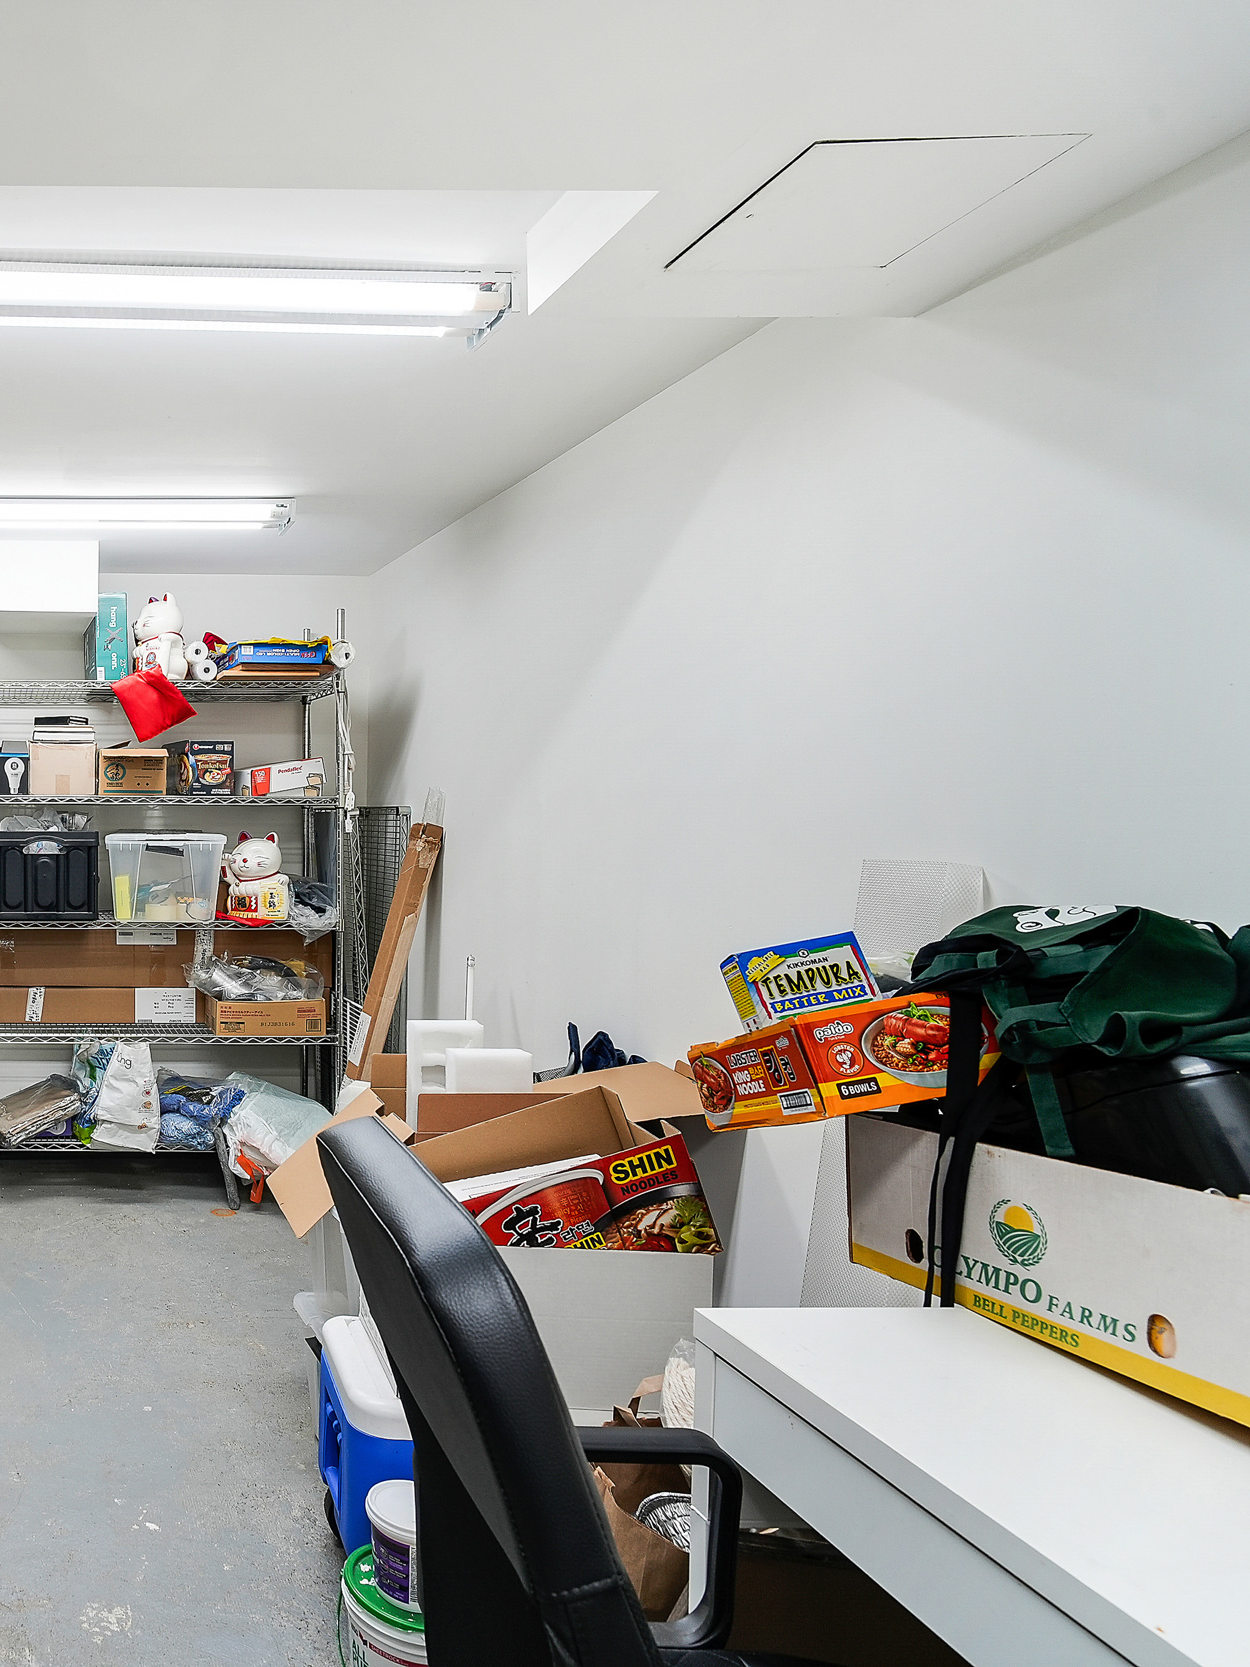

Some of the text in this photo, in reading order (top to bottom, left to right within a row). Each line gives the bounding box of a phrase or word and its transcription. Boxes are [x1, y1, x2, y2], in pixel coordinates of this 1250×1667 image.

[197, 761, 227, 769] Tonkotsu
[277, 765, 303, 774] Pendaflex
[787, 957, 829, 970] KIKKOMAN
[761, 961, 861, 998] TEMPURA
[774, 987, 865, 1011] BATTER MIX
[814, 1020, 854, 1043] paldo
[726, 1049, 760, 1069] LOBSTER
[831, 1044, 855, 1054] LOBSTER
[733, 1071, 750, 1083] KING
[840, 1064, 860, 1074] FLAVOR
[737, 1080, 766, 1095] NOODLE
[841, 1082, 877, 1096] 6 BOWLS
[611, 1146, 677, 1183] SHIN
[621, 1170, 678, 1196] NOODLES
[560, 1220, 594, 1242] 라면
[973, 1293, 1080, 1348] BELL PEPPERS
[1046, 1294, 1138, 1343] FARMS
